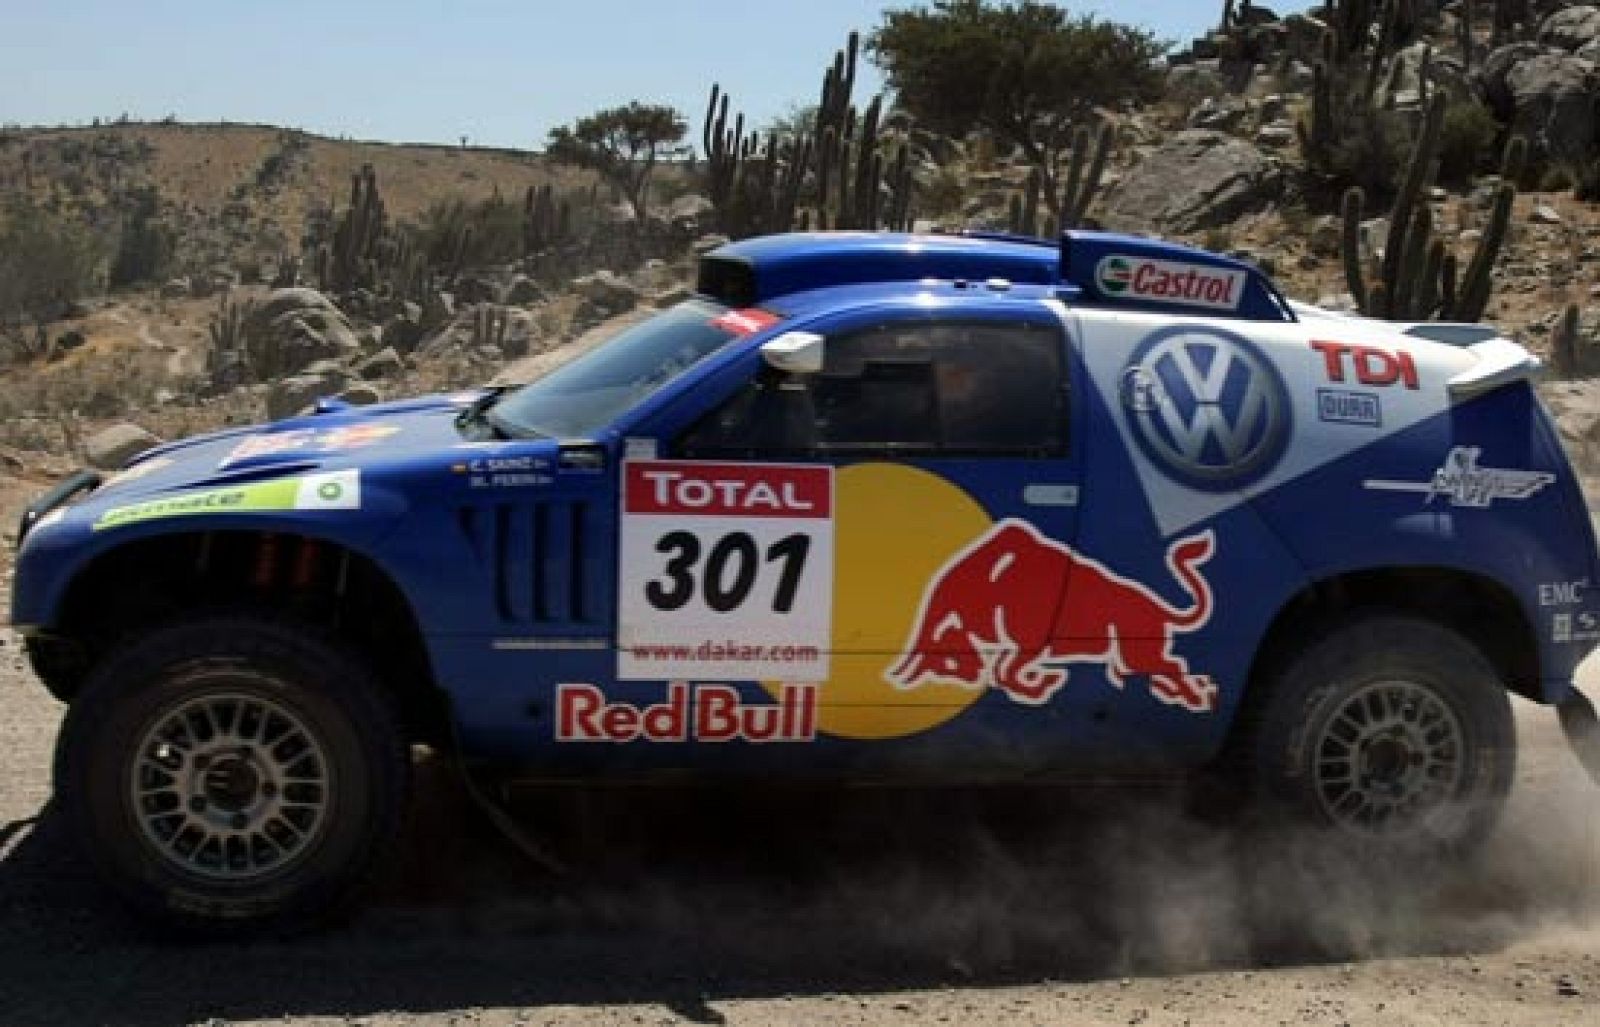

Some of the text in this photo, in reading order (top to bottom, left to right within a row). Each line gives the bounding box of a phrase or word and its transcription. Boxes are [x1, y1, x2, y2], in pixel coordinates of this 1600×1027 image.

[1133, 261, 1235, 304] Castrol
[1309, 339, 1419, 390] TDI
[641, 470, 815, 512] TOTAL
[644, 530, 813, 614] 301
[632, 640, 820, 663] www.dakar.com
[555, 683, 819, 742] Red Bull
